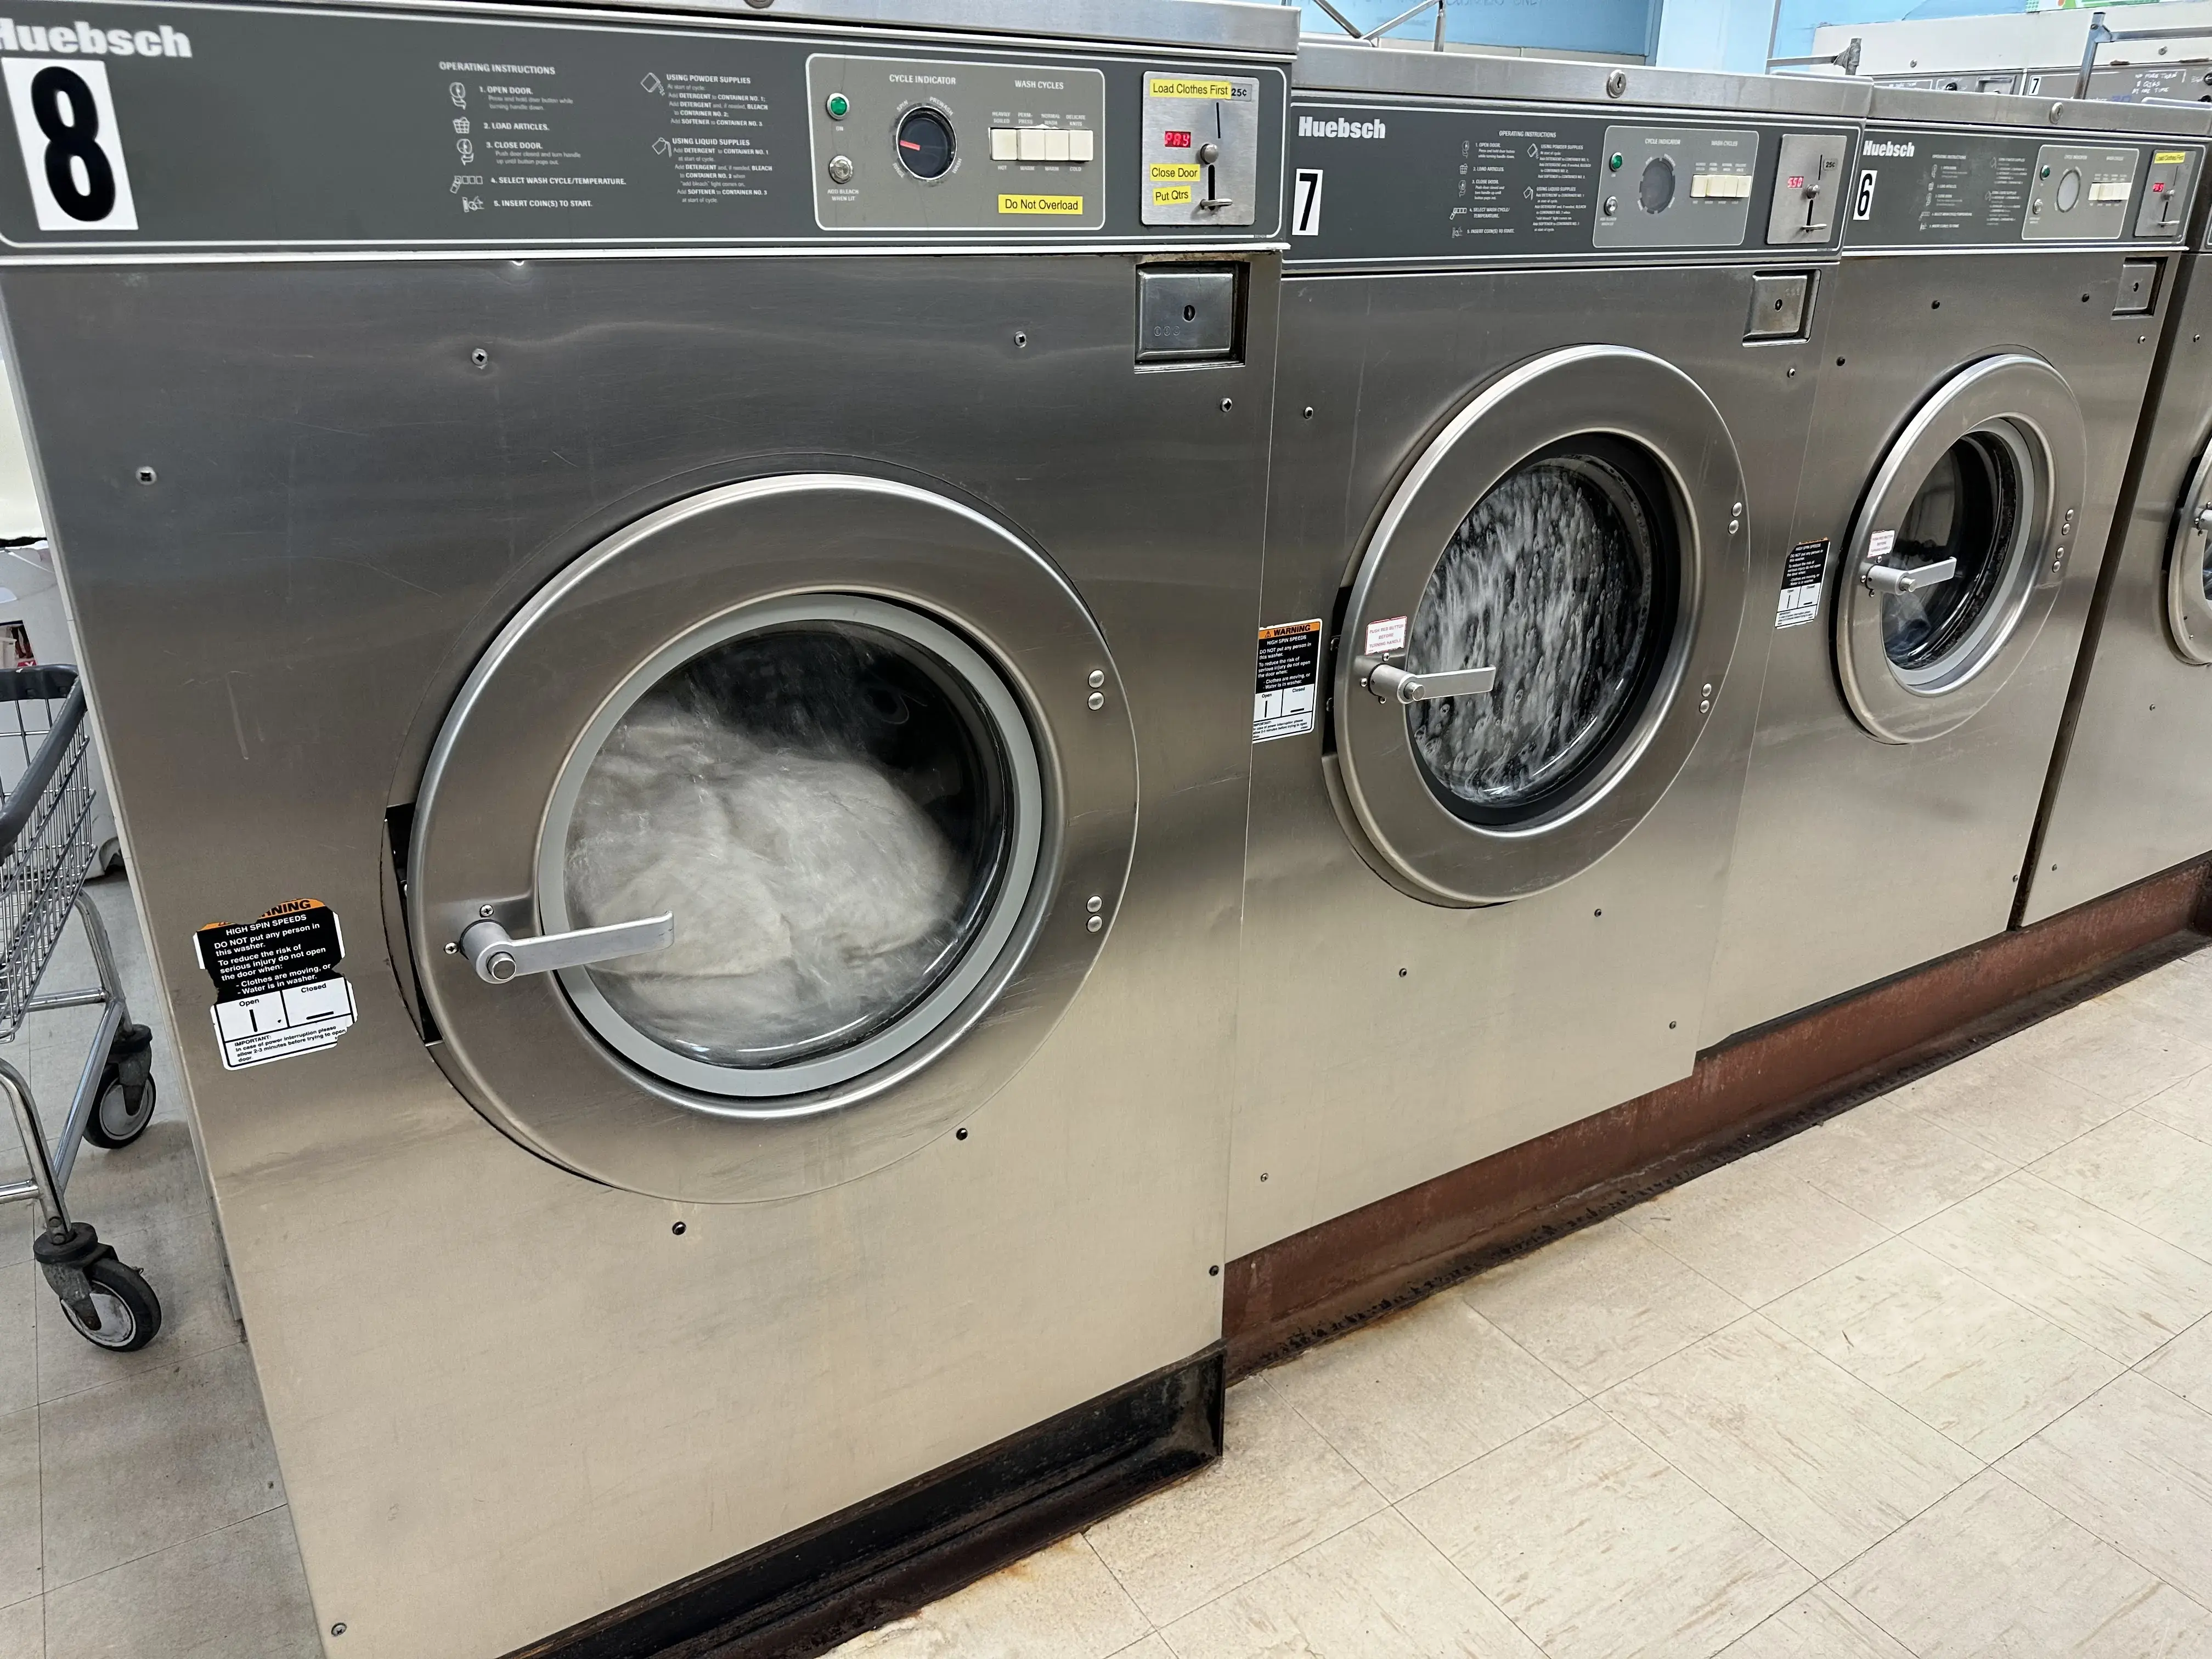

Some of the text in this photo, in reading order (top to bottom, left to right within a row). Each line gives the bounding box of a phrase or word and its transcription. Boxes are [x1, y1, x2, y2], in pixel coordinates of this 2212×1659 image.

[0, 18, 192, 57] Huebsch
[439, 61, 556, 75] OPERATING INSTRUCTIONS
[889, 74, 956, 84] CYCLE INDICATOR
[1014, 80, 1064, 90] WASH CYCLES
[2032, 78, 2039, 94] 7
[487, 86, 507, 94] OPEN
[1153, 83, 1228, 95] Load Clothes First
[896, 100, 909, 112] SPIN
[929, 97, 953, 116] PREWASH
[1298, 116, 1386, 138] Huebsch
[31, 66, 116, 222] 8
[1165, 132, 1190, 146] PAY
[1863, 140, 1915, 157] Huebsch
[1152, 168, 1198, 177] Close Door
[1155, 190, 1189, 201] Put Qtrs
[1858, 173, 1872, 216] 6
[1005, 199, 1078, 210] Do Not Overload
[1299, 173, 1318, 231] 7
[1274, 624, 1311, 636] WARNING
[226, 914, 307, 935] HIGH SPIN SPEEDS
[229, 937, 247, 946] NOT
[250, 934, 264, 943] put
[283, 925, 311, 937] person
[216, 943, 266, 957] this washer.
[230, 953, 259, 963] reduce
[276, 946, 291, 955] risk
[220, 962, 251, 974] serious
[253, 957, 276, 967] injury
[291, 951, 304, 959] not
[306, 947, 326, 956] open
[236, 969, 256, 978] door
[258, 964, 283, 973] when:
[241, 976, 273, 987] Clothes
[289, 966, 321, 977] moving,
[241, 985, 266, 995] Water
[286, 974, 318, 985] washer.
[301, 983, 326, 993] Closed
[239, 998, 259, 1007] Open
[235, 1035, 272, 1047] IMPORTANT:
[265, 1038, 283, 1046] power
[284, 1030, 317, 1041] interruption
[318, 1025, 336, 1034] please
